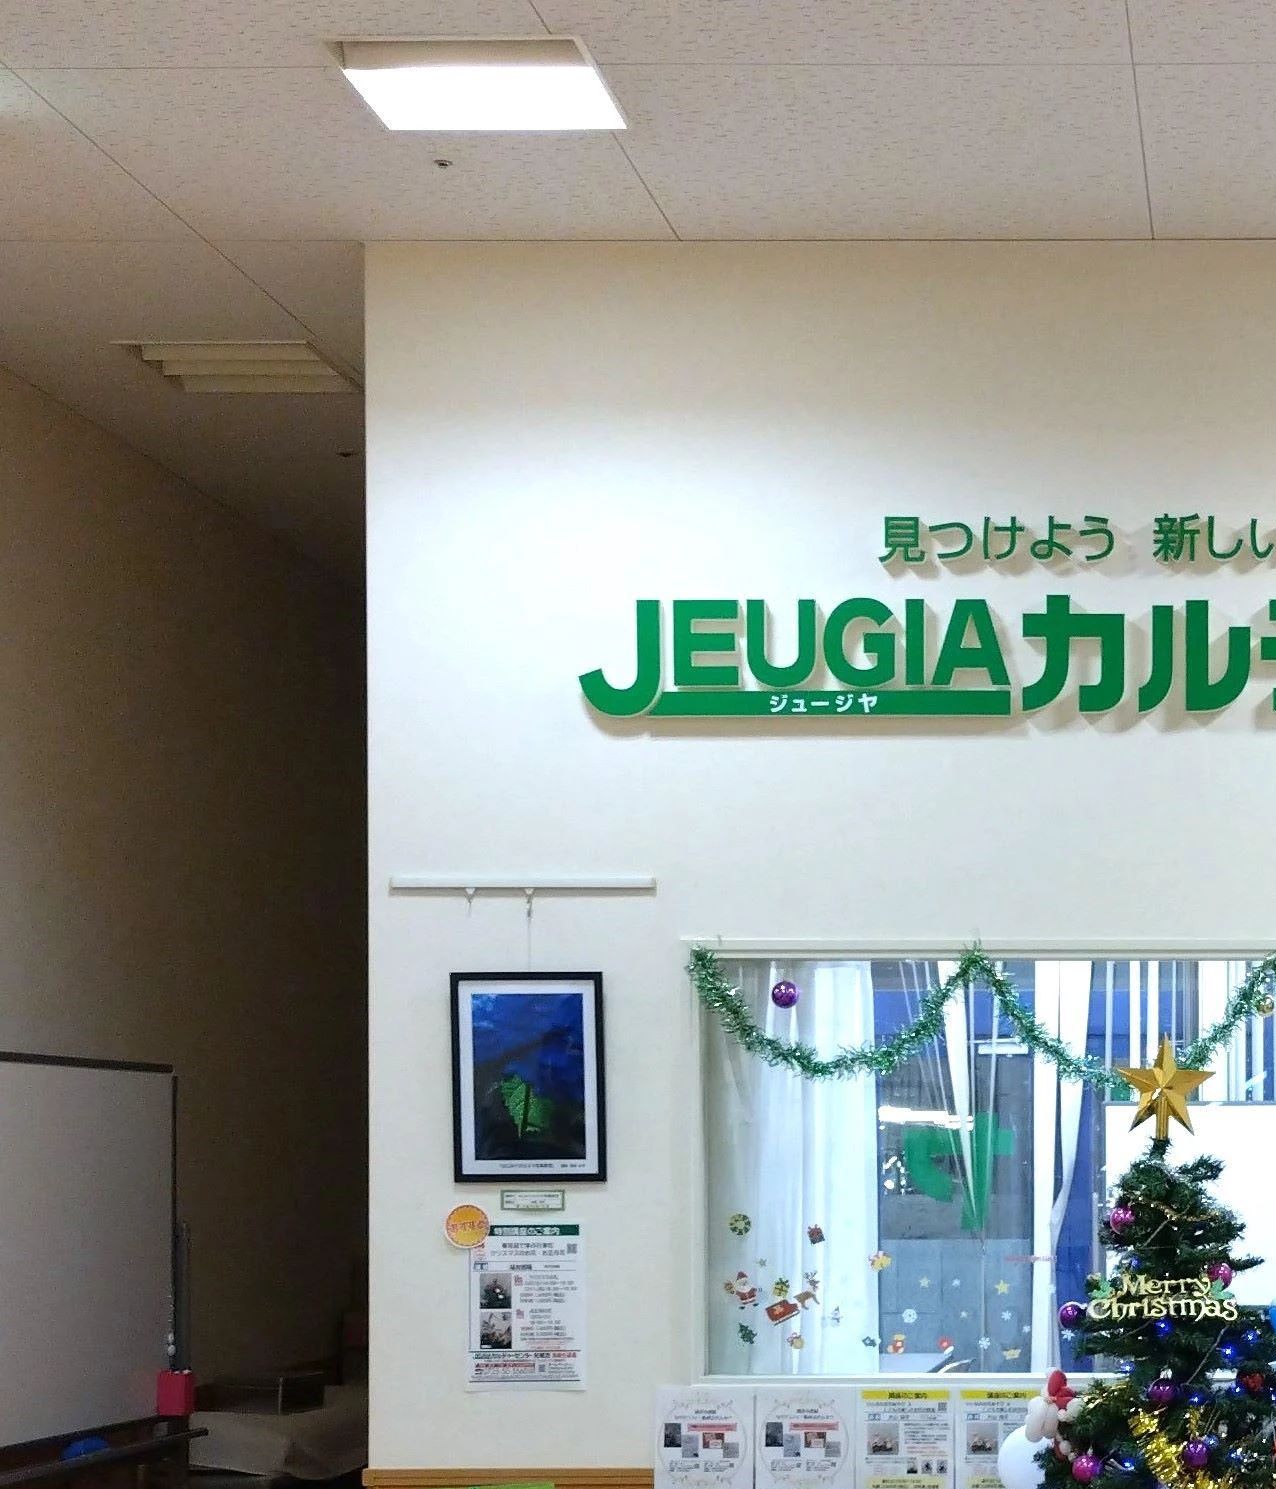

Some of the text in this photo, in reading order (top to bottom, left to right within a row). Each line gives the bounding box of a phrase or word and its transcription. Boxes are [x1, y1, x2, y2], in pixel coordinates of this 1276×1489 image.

[879, 515, 1115, 564] 見つけよう
[1119, 1273, 1211, 1297] Merry
[1086, 1298, 1238, 1321] Christmas
